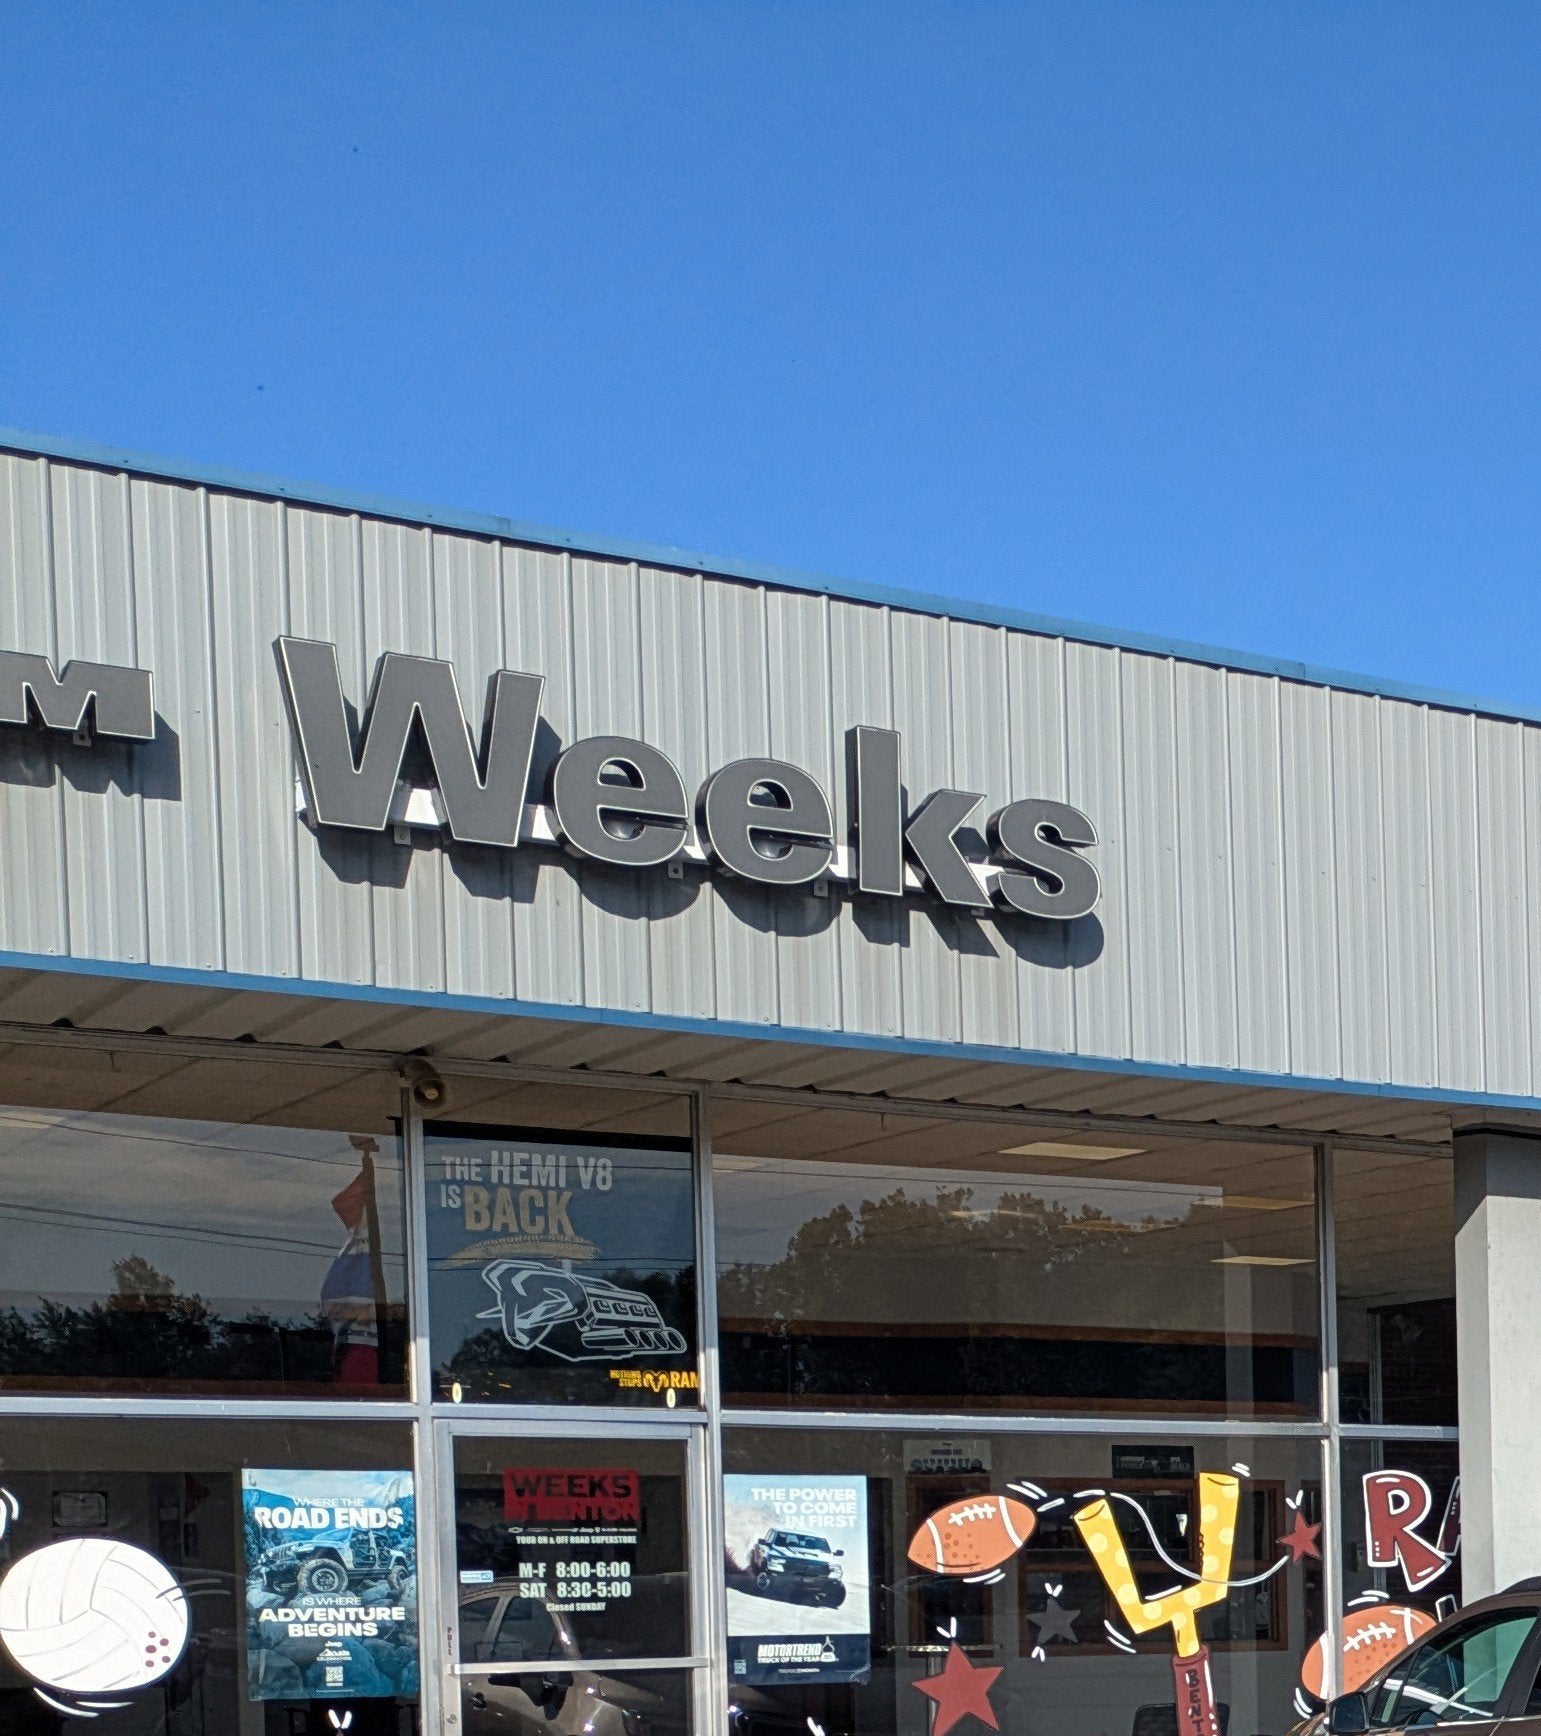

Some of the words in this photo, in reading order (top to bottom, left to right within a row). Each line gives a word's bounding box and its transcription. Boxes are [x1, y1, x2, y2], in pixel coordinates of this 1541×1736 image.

[273, 635, 1101, 921] Weeks
[441, 1155, 483, 1182] THE
[490, 1150, 567, 1188] HEMI
[576, 1156, 613, 1191] V8
[440, 1184, 461, 1209] IS
[464, 1184, 574, 1240] BACK
[510, 1473, 632, 1499] WEEKS
[750, 1488, 786, 1501] THE
[789, 1488, 857, 1501] POWER
[293, 1499, 338, 1507] WHERE
[342, 1499, 365, 1507] THE
[773, 1502, 797, 1514] TO
[800, 1502, 857, 1514] COME
[255, 1506, 330, 1529] ROAD
[335, 1507, 403, 1529] ENDS
[785, 1515, 805, 1528] IN
[808, 1515, 857, 1528] FIRST
[516, 1535, 536, 1545] YOUR
[537, 1535, 549, 1545] ON
[569, 1535, 590, 1545] ROAD
[591, 1535, 638, 1545] SUPERSTORE
[518, 1562, 547, 1578] M-F
[555, 1561, 631, 1578] 8:00-6:00
[519, 1582, 548, 1599] SAT
[556, 1581, 632, 1598] 8:30-5:00
[302, 1597, 314, 1606] IS
[316, 1597, 362, 1606] WHERE
[546, 1602, 575, 1612] Closed
[575, 1602, 607, 1612] SUNDAY
[258, 1606, 406, 1623] ADVENTURE
[288, 1622, 379, 1638] BEGINS
[757, 1643, 822, 1658] MOTORTREND
